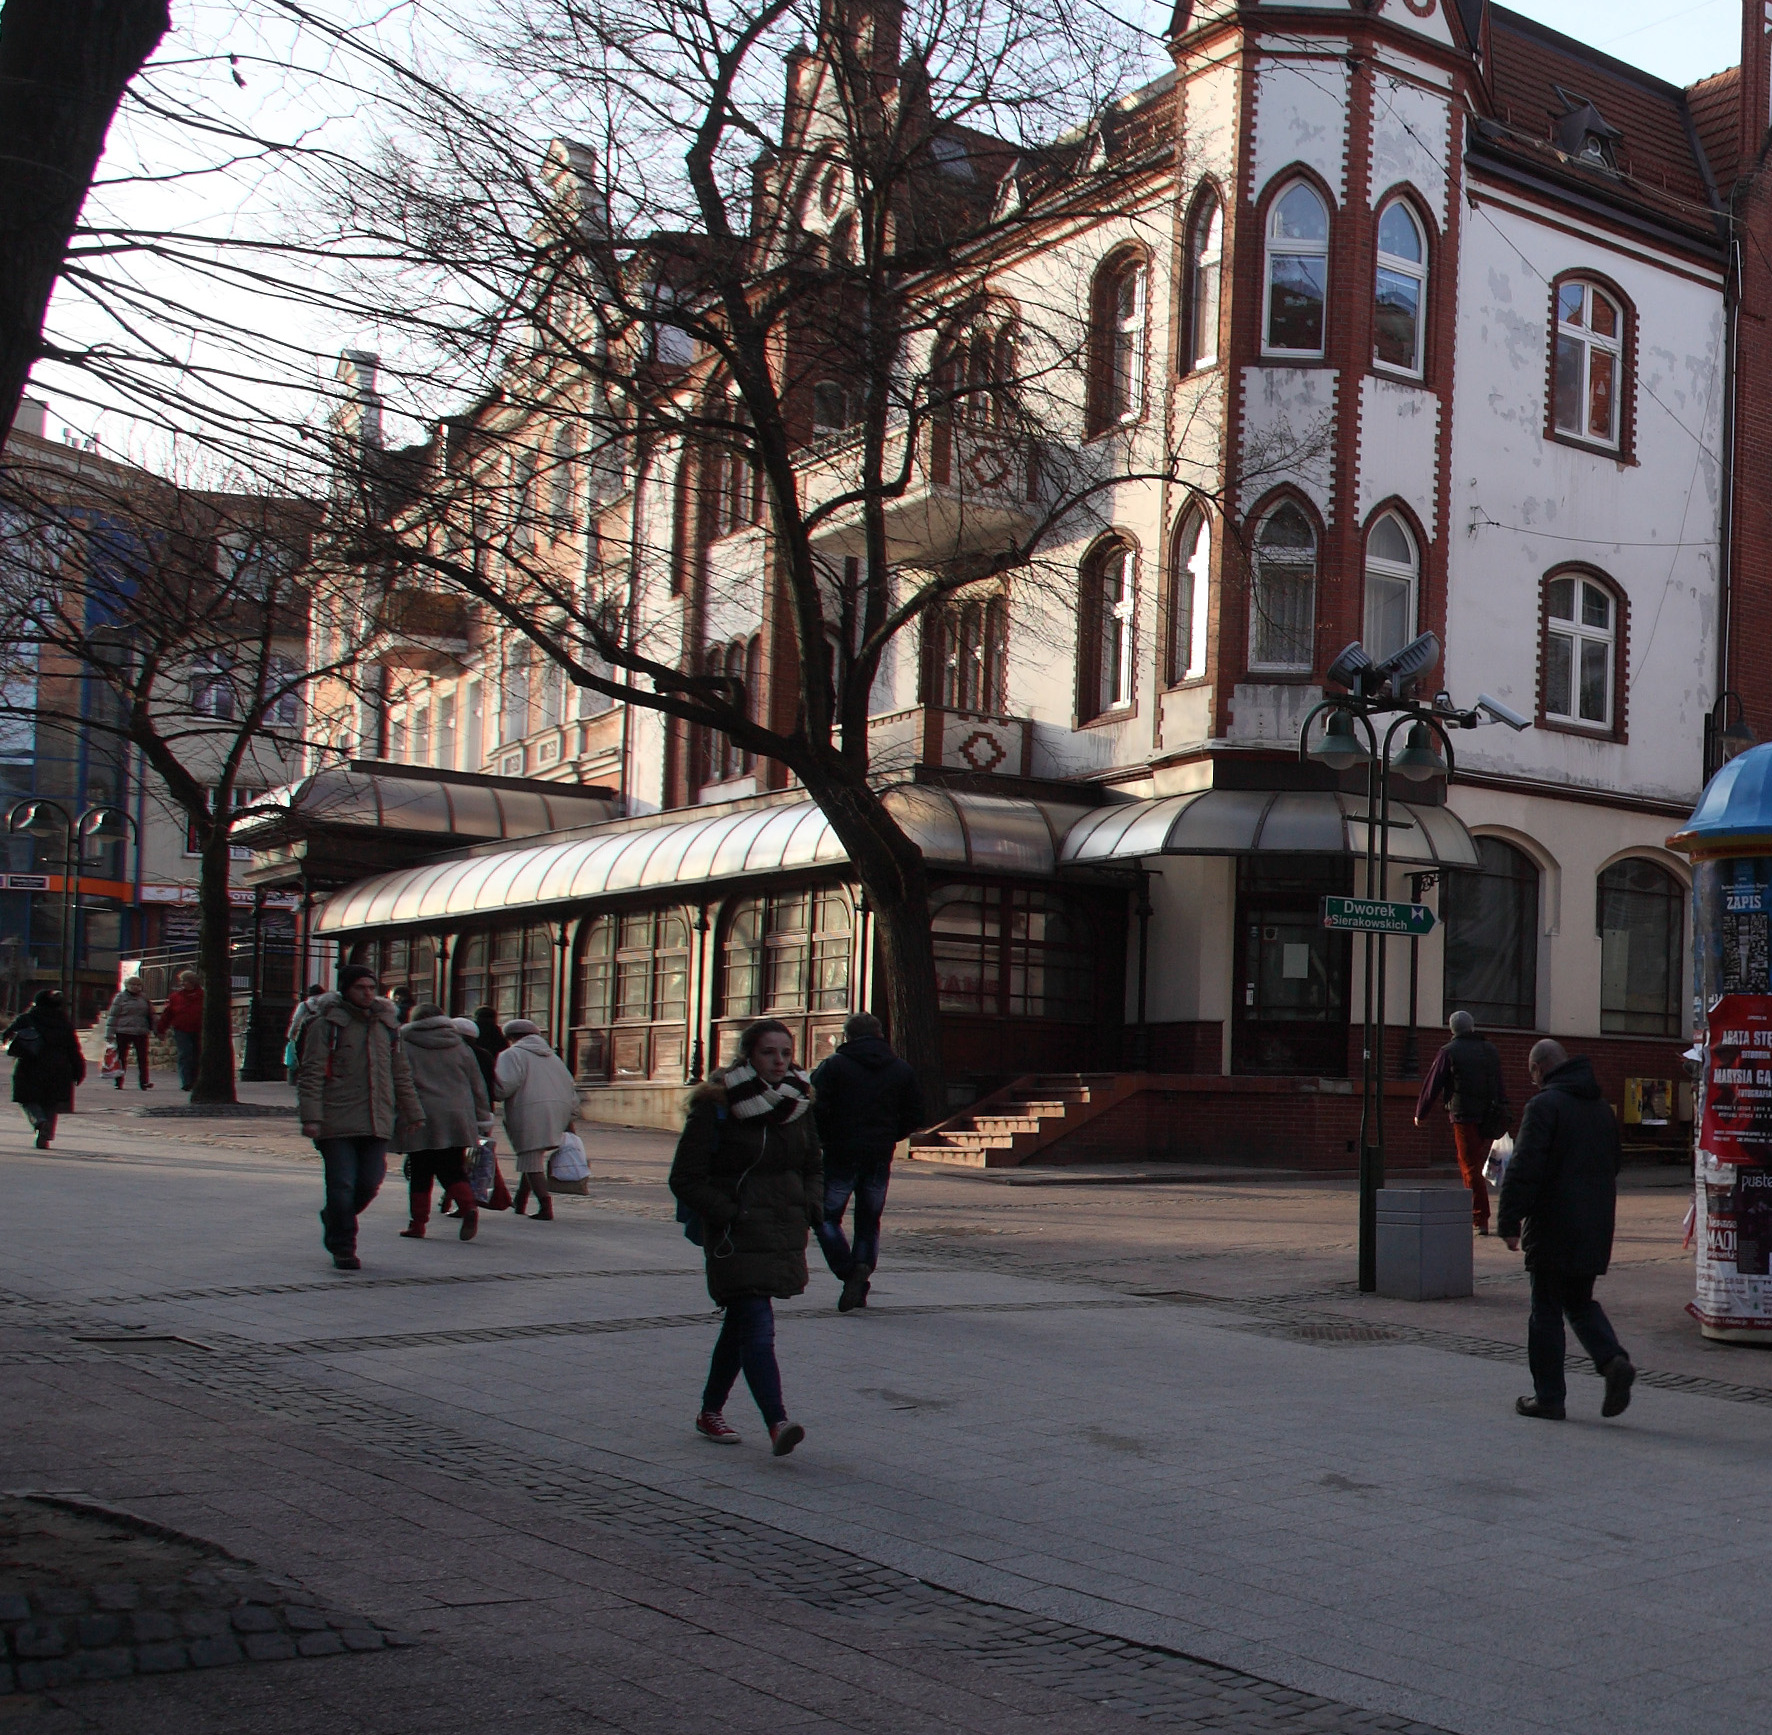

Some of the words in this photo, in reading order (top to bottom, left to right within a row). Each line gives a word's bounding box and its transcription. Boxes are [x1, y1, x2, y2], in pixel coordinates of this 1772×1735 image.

[1344, 900, 1397, 918] Dworek
[1727, 895, 1762, 910] ZAPIS
[1332, 914, 1408, 931] Sierakowskich
[1722, 1030, 1750, 1045] AGATA
[1714, 1069, 1752, 1084] MARYSIA
